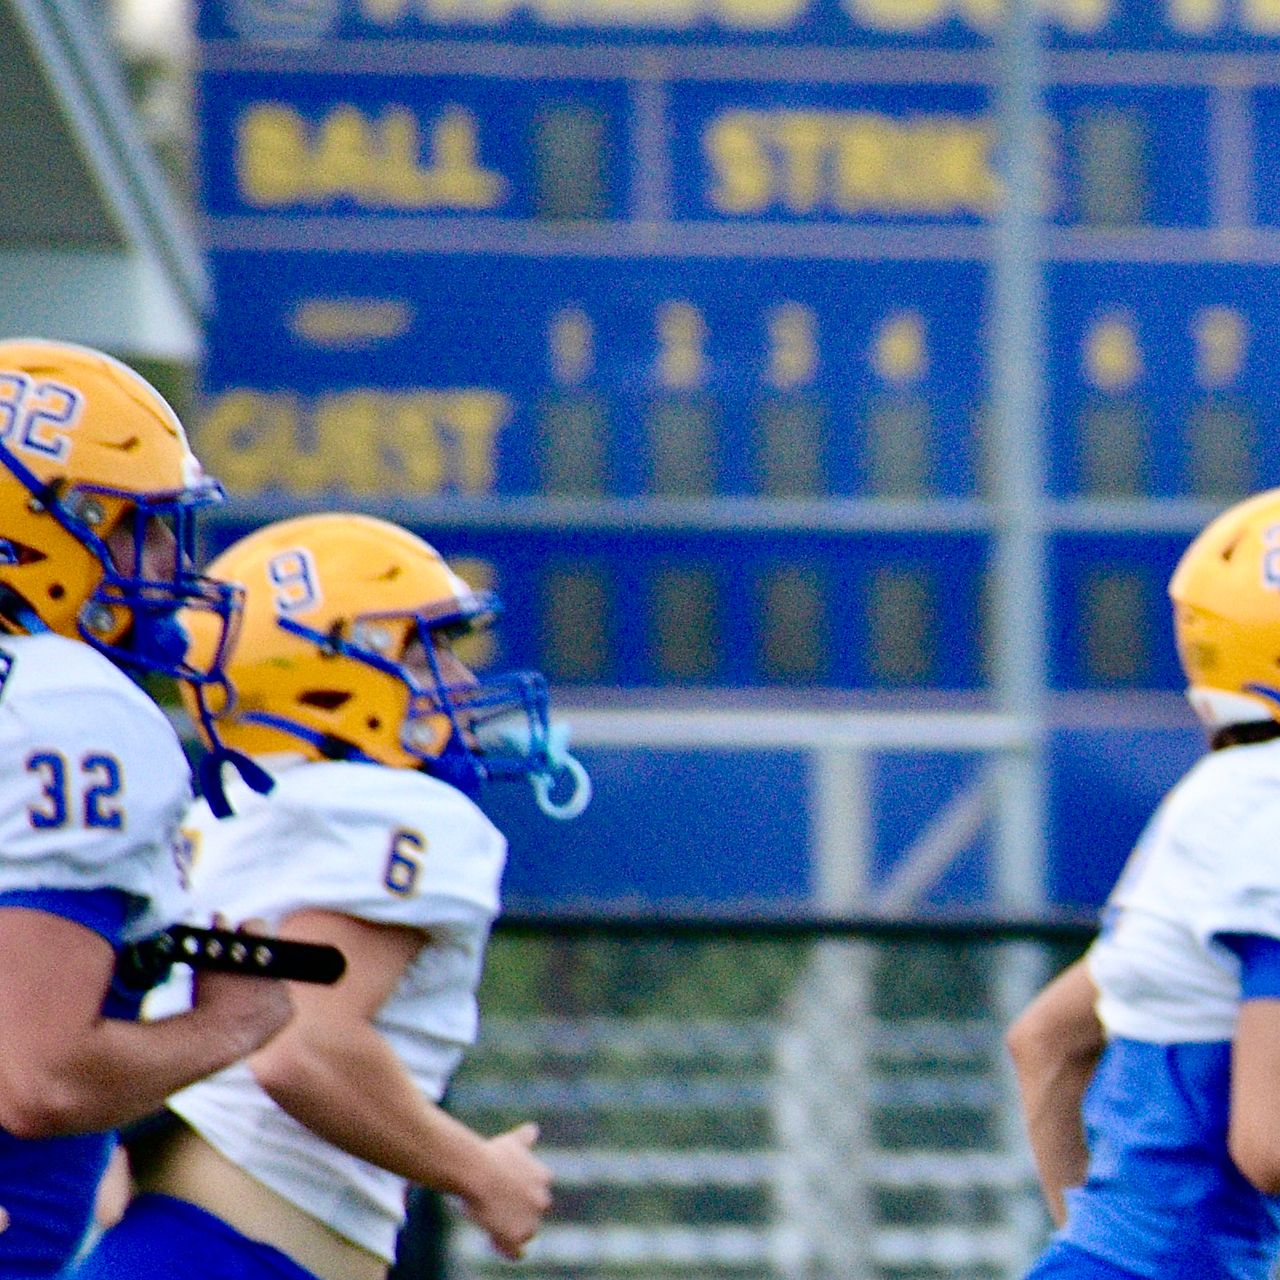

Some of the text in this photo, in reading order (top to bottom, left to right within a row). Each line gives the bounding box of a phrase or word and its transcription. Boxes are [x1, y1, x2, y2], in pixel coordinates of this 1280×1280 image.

[236, 101, 506, 209] BALL
[704, 108, 1056, 216] STRIK
[204, 388, 508, 502] GUEST
[268, 548, 318, 611] 9
[26, 749, 124, 829] 32
[382, 828, 426, 899] 6
